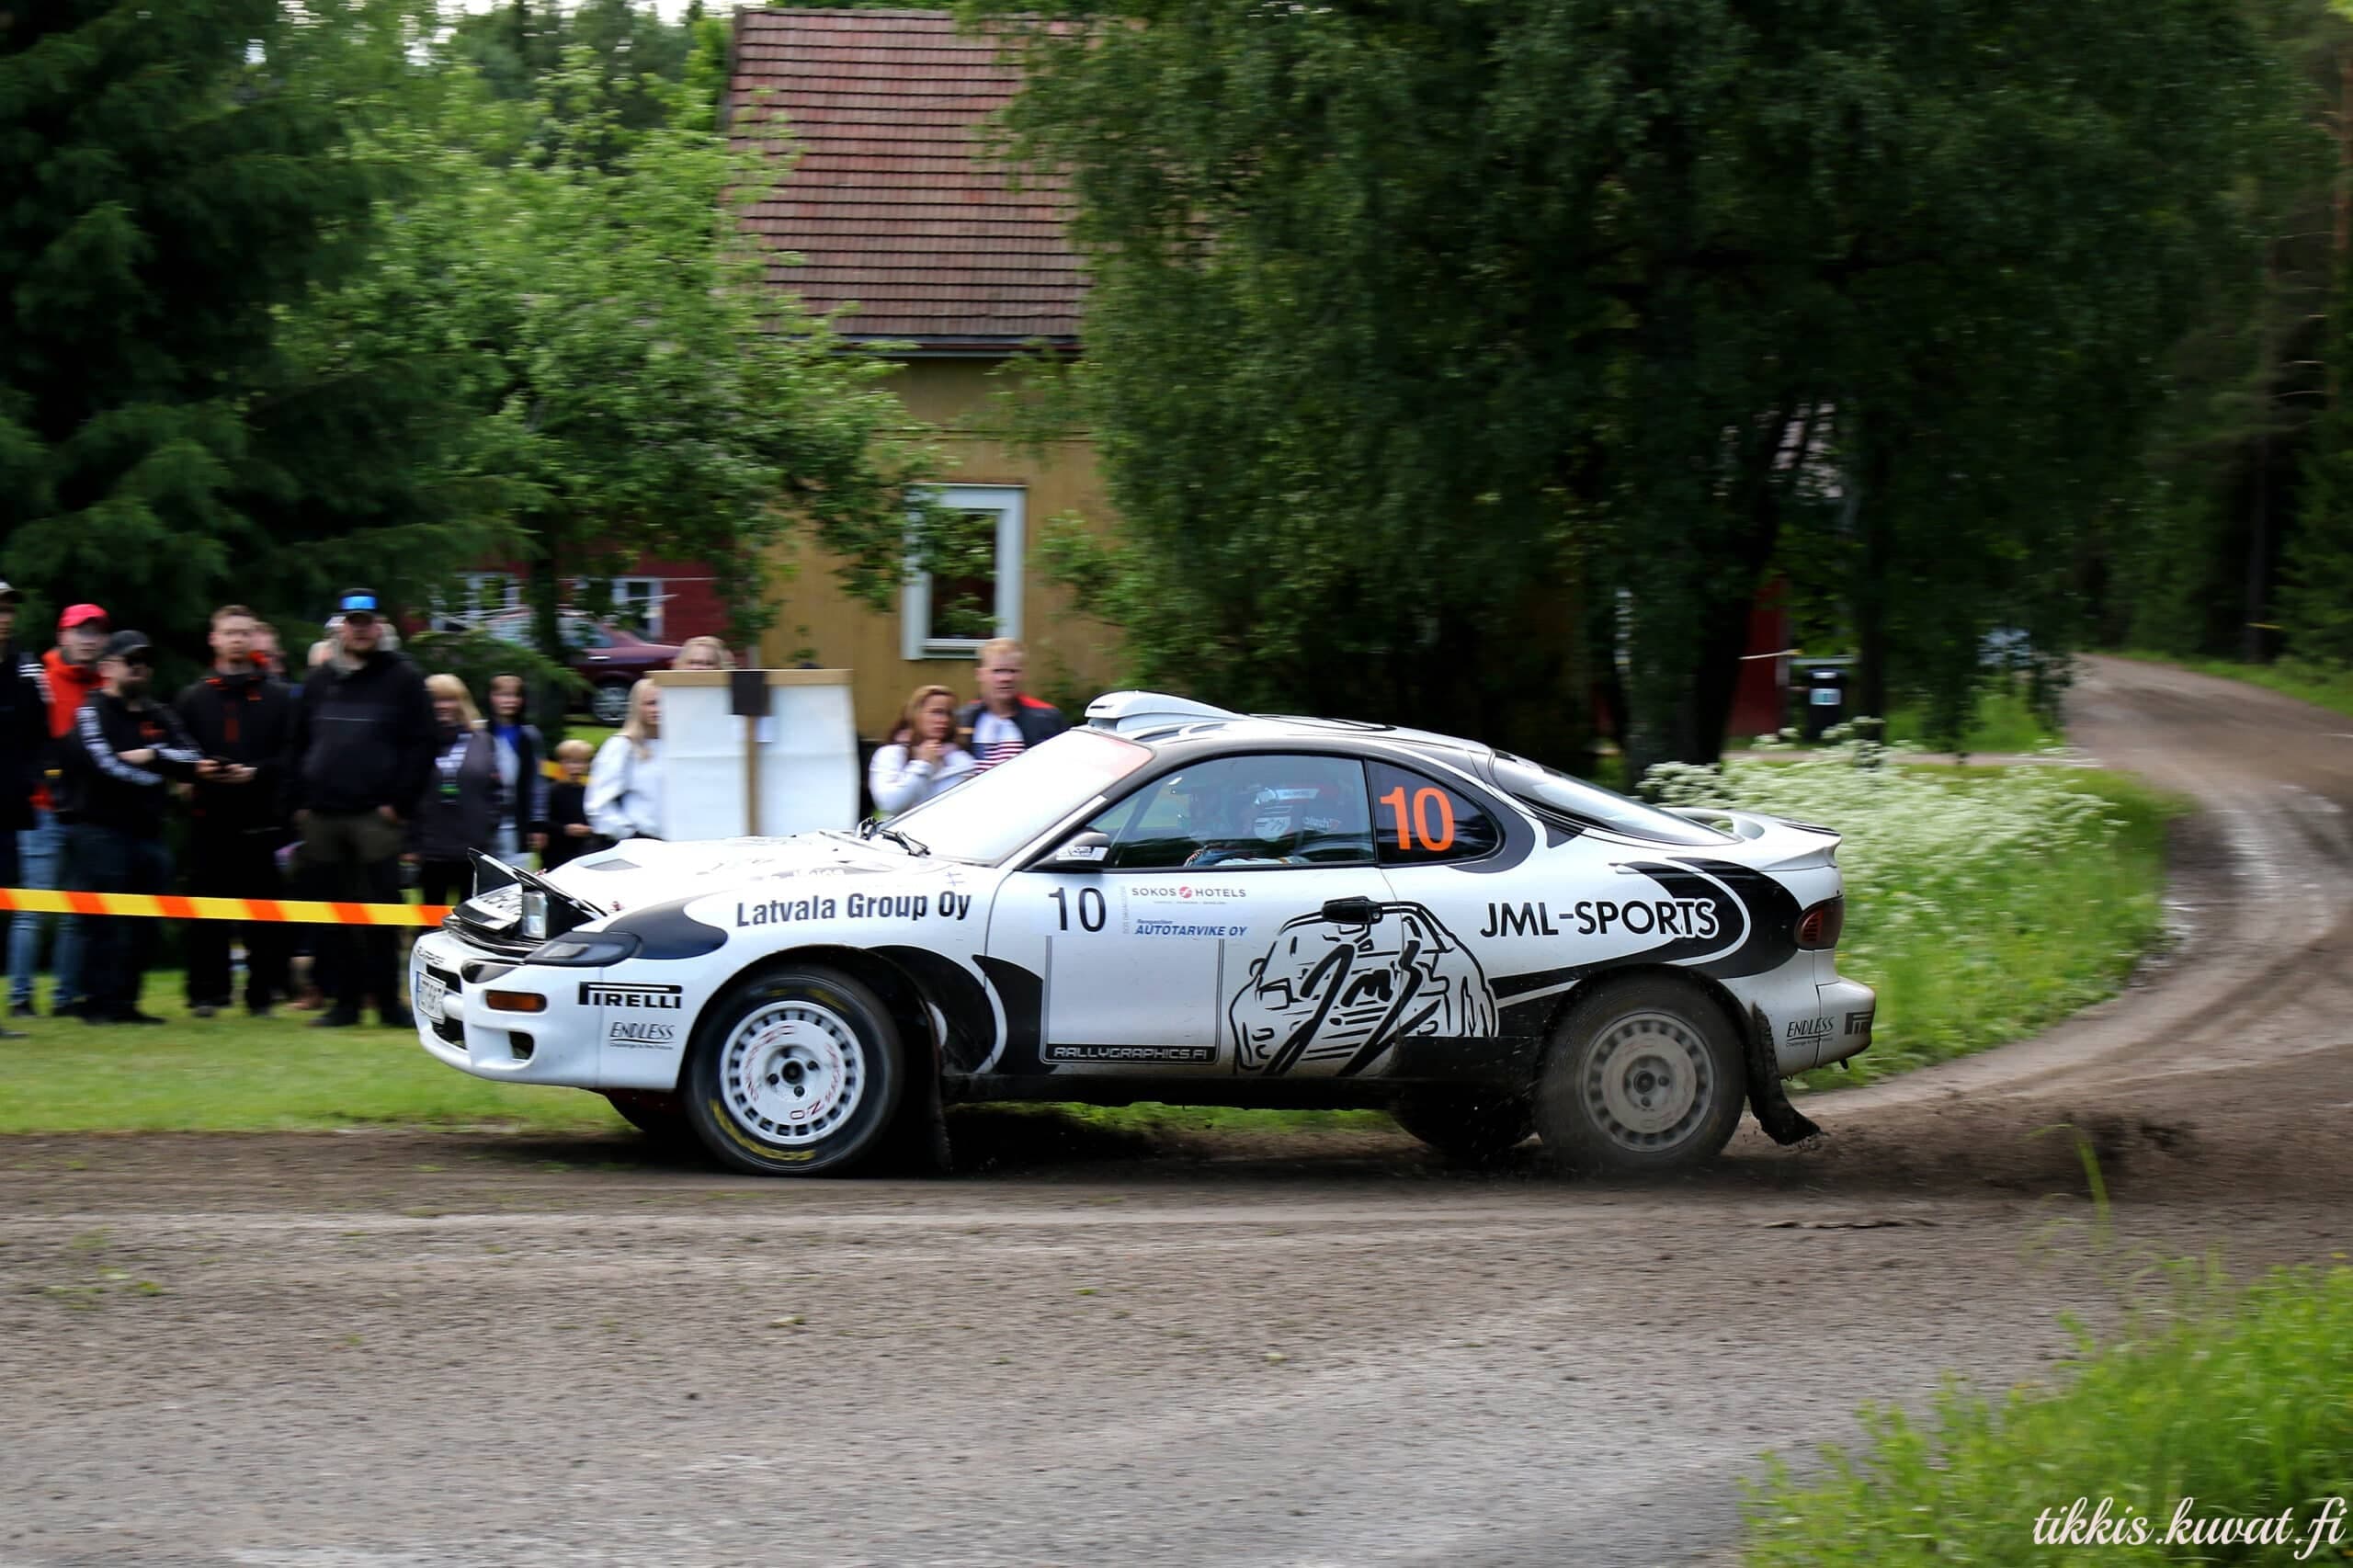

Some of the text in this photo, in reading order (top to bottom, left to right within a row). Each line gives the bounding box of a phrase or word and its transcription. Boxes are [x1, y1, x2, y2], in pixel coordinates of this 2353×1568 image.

[1380, 786, 1455, 851] 10
[1131, 887, 1246, 898] SOKOS HOTELS
[736, 890, 972, 927] Latvala Group Oy
[1048, 886, 1107, 933] 10
[1480, 900, 1720, 938] JML-SPORTS
[1133, 925, 1248, 937] AUTOTARVIKE OY
[577, 981, 683, 1009] PIRELLI
[609, 1021, 676, 1040] ENDLESS
[1786, 1016, 1836, 1038] ENDLESS
[1053, 1046, 1208, 1060] RALLYGRAPHICS.FI
